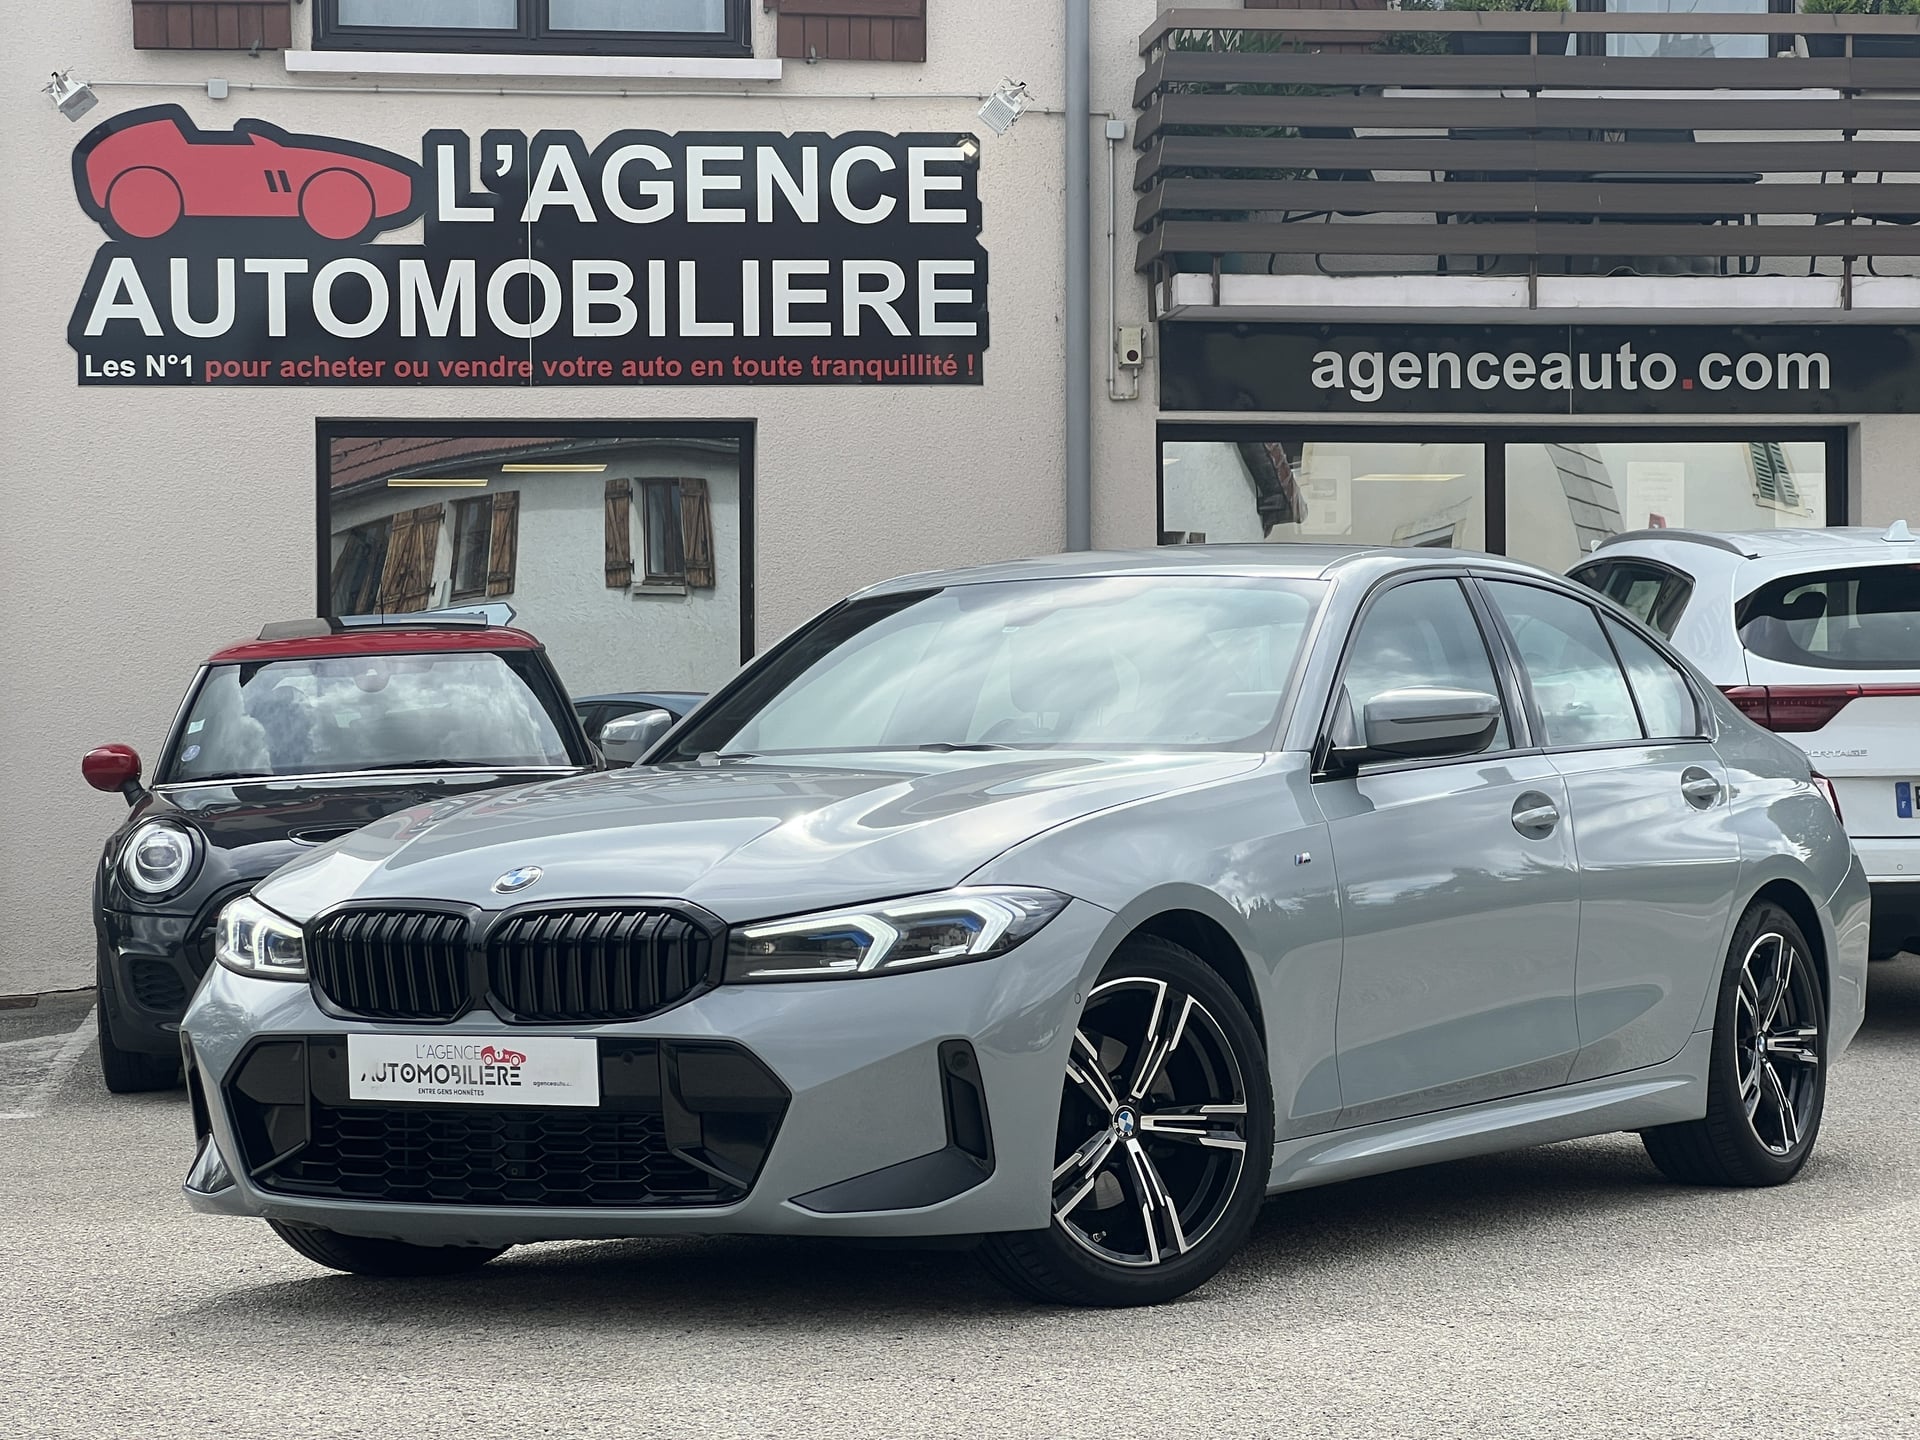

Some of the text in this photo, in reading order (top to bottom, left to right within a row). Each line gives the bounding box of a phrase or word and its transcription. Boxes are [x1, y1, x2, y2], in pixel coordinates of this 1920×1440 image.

[437, 144, 968, 223] L'AGENCE
[84, 257, 977, 338] AUTOMOBILIERE
[85, 355, 135, 377] Les
[146, 354, 192, 377] N°1
[205, 362, 269, 382] pour
[280, 357, 385, 378] acheter
[394, 361, 429, 378] ou
[439, 357, 532, 378] vendre
[543, 358, 612, 378] votre
[622, 358, 683, 378] auto
[691, 361, 724, 378] en
[732, 357, 802, 378] toute
[811, 356, 957, 380] tranquillité
[1311, 342, 1830, 401] agenceauto.com
[416, 1044, 481, 1061] L'AGENCE
